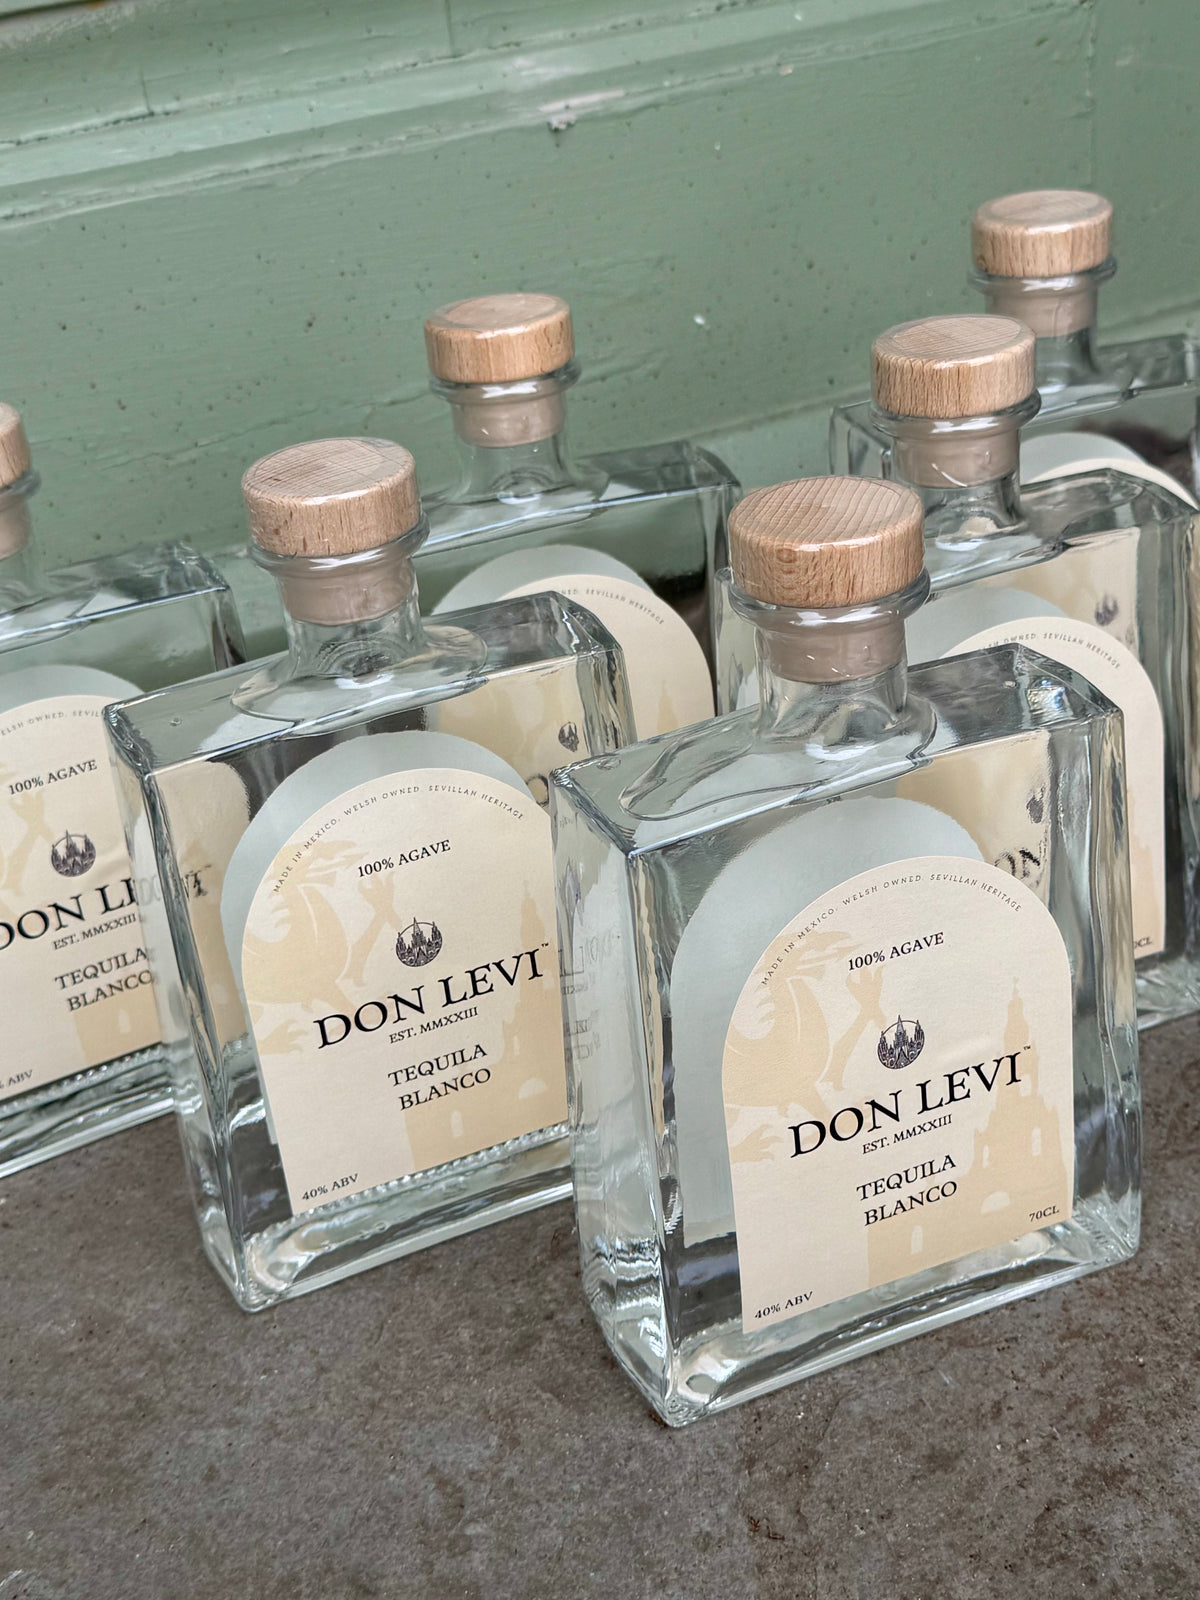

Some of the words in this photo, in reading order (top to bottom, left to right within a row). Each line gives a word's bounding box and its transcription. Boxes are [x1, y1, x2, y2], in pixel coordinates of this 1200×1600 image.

[1043, 632, 1084, 646] SEVILLAN
[1086, 641, 1121, 669] HERITAGE
[0, 722, 24, 736] ELSH
[72, 710, 100, 718] SEVIL
[8, 776, 44, 795] 100%
[47, 759, 98, 784] AGAVE
[273, 863, 293, 893] MADE
[292, 850, 303, 864] IN
[343, 796, 379, 816] WELSH
[428, 784, 478, 798] SEVILLAN
[481, 793, 525, 820] HERITAGE
[357, 856, 395, 878] 100%
[398, 839, 451, 866] AGAVE
[53, 932, 80, 950] EST.
[83, 912, 137, 938] MMXXIII
[760, 956, 784, 987] MADE
[784, 941, 797, 955] IN
[842, 885, 879, 906] WELSH
[929, 873, 979, 887] SEVILLAN
[980, 882, 1023, 912] HERITAGE
[1134, 936, 1152, 949] CL
[54, 947, 149, 990] TEQUILA
[847, 949, 886, 971] 100%
[889, 931, 945, 959] AGAVE
[67, 969, 154, 1012] BLANCO
[312, 985, 427, 1050] DON
[389, 1027, 418, 1045] EST.
[420, 1006, 479, 1035] MMXXIII
[387, 1044, 488, 1087] TEQUILA
[398, 1067, 492, 1111] BLANCO
[787, 1089, 903, 1159] DON
[861, 1136, 890, 1155] EST.
[892, 1113, 953, 1144] MMXXIII
[301, 1184, 329, 1201] 40%
[331, 1173, 359, 1192] ABV
[856, 1154, 957, 1201] TEQUILA
[864, 1180, 959, 1227] BLANCO
[1028, 1204, 1060, 1222] 70CL
[754, 1303, 782, 1320] 40%
[784, 1290, 814, 1310] ABV
